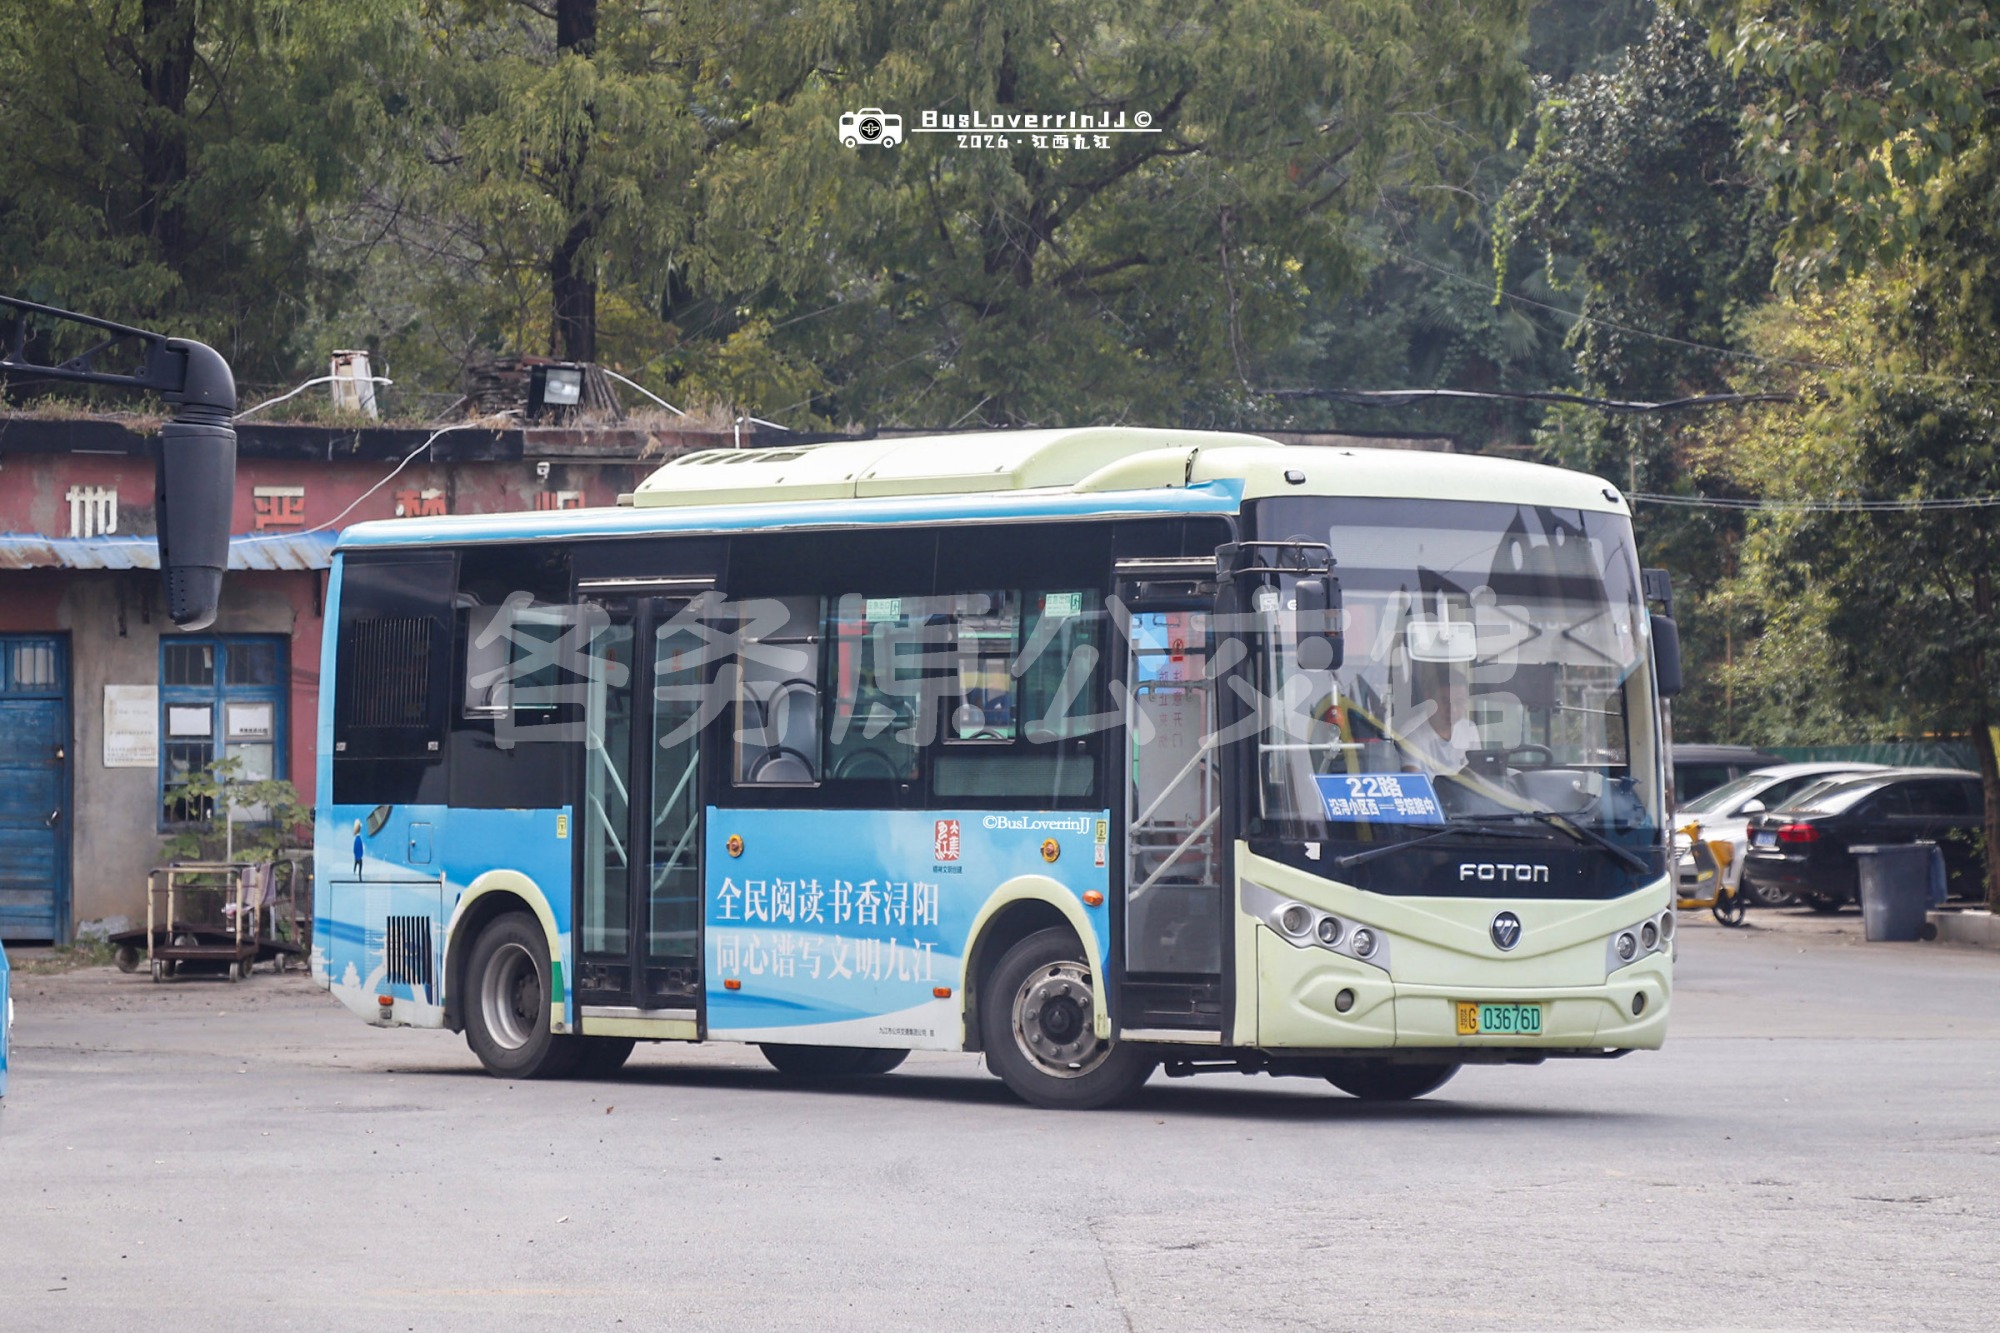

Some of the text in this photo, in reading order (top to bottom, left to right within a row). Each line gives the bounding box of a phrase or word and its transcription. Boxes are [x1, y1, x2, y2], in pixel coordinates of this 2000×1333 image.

[1345, 776, 1403, 798] 22路
[1458, 863, 1549, 883] FOTON
[716, 876, 940, 927] 全民阅读书香浔阳
[716, 932, 940, 984] 同心谱写文明九江
